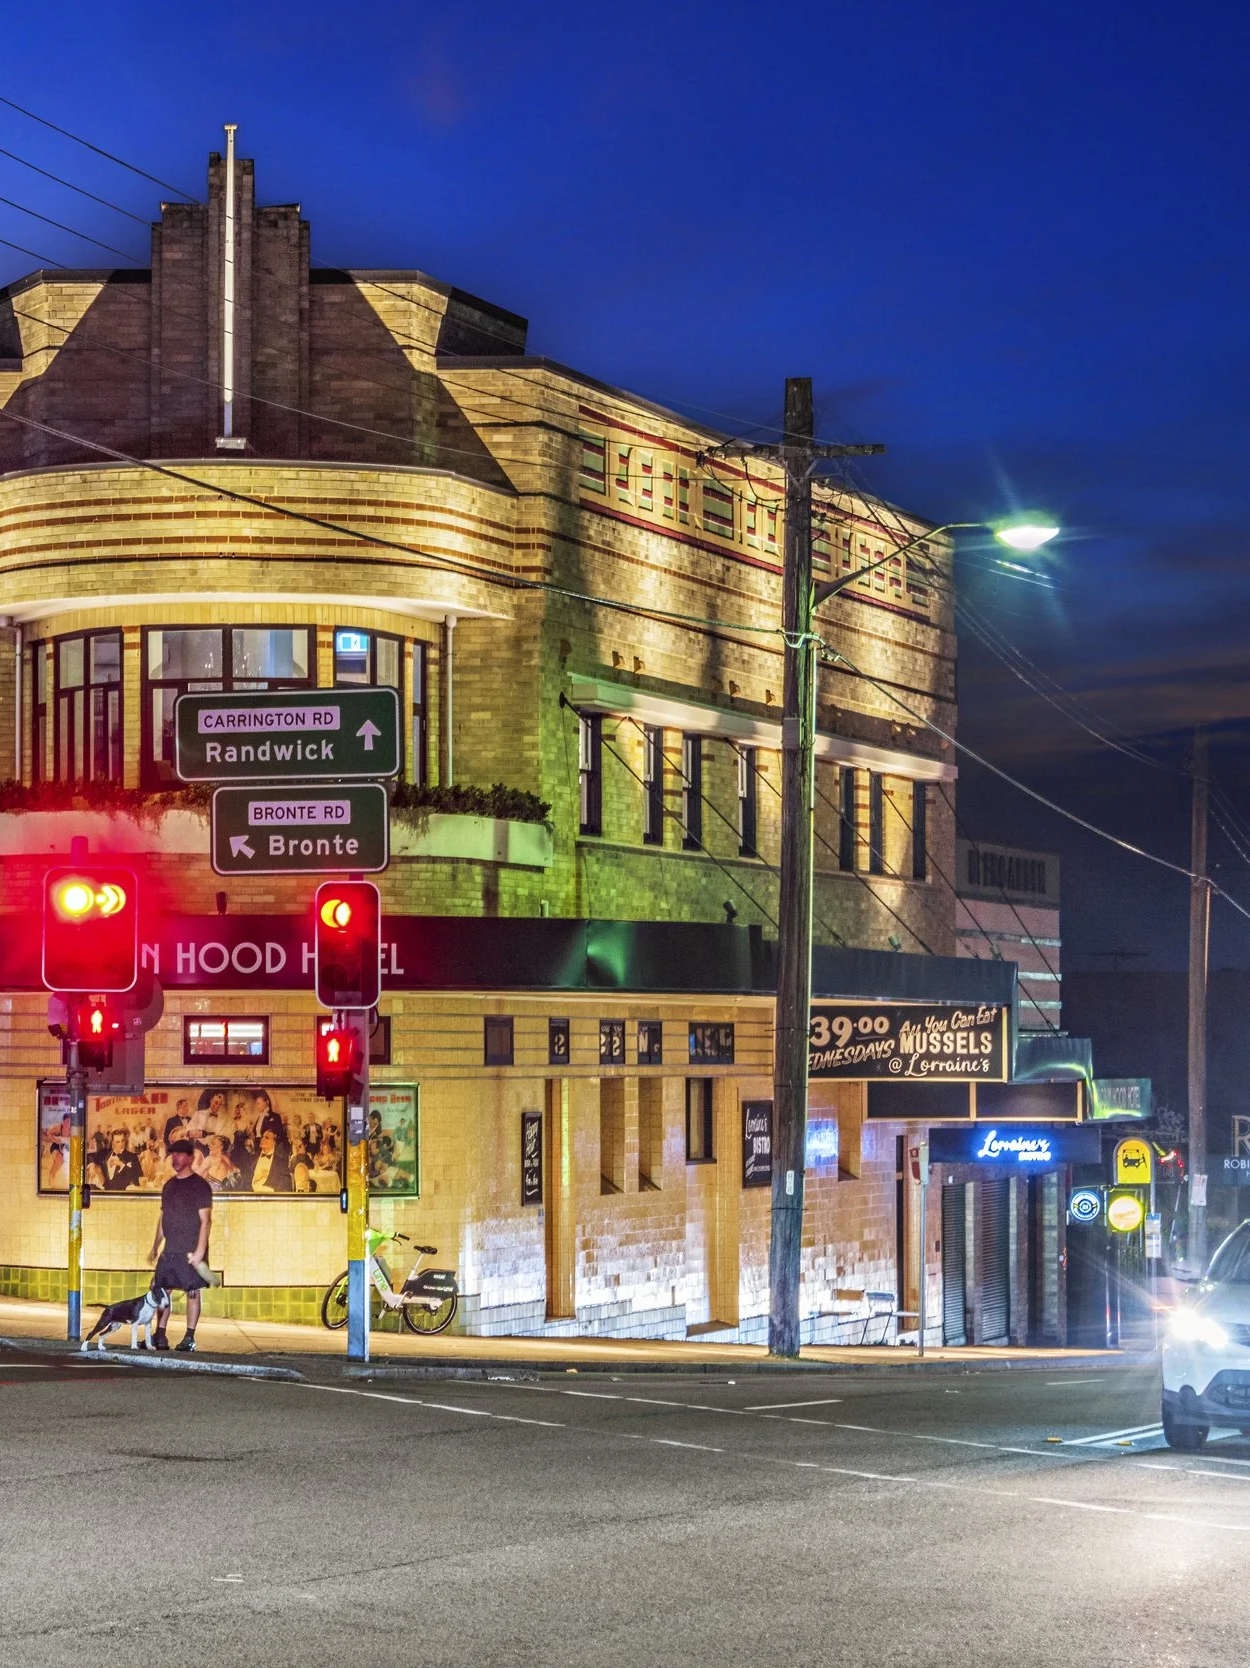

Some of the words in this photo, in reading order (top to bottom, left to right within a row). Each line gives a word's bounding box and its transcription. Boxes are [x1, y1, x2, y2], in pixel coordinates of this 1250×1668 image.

[204, 712, 306, 728] CARRINGTON
[313, 712, 334, 725] RD
[205, 739, 335, 762] Randwick
[253, 806, 317, 820] BRONTE
[324, 805, 345, 819] RD
[269, 834, 359, 856] Bronte
[177, 942, 286, 974] HOOD
[302, 943, 405, 975] HEL
[925, 1016, 947, 1034] You
[951, 1011, 974, 1030] Can
[976, 1006, 997, 1024] Eat
[900, 1031, 992, 1054] MUSSELS
[808, 1039, 895, 1072] EDNESDAYS
[904, 1053, 990, 1077] Lorraine's
[977, 1130, 1050, 1158] Lorraine's
